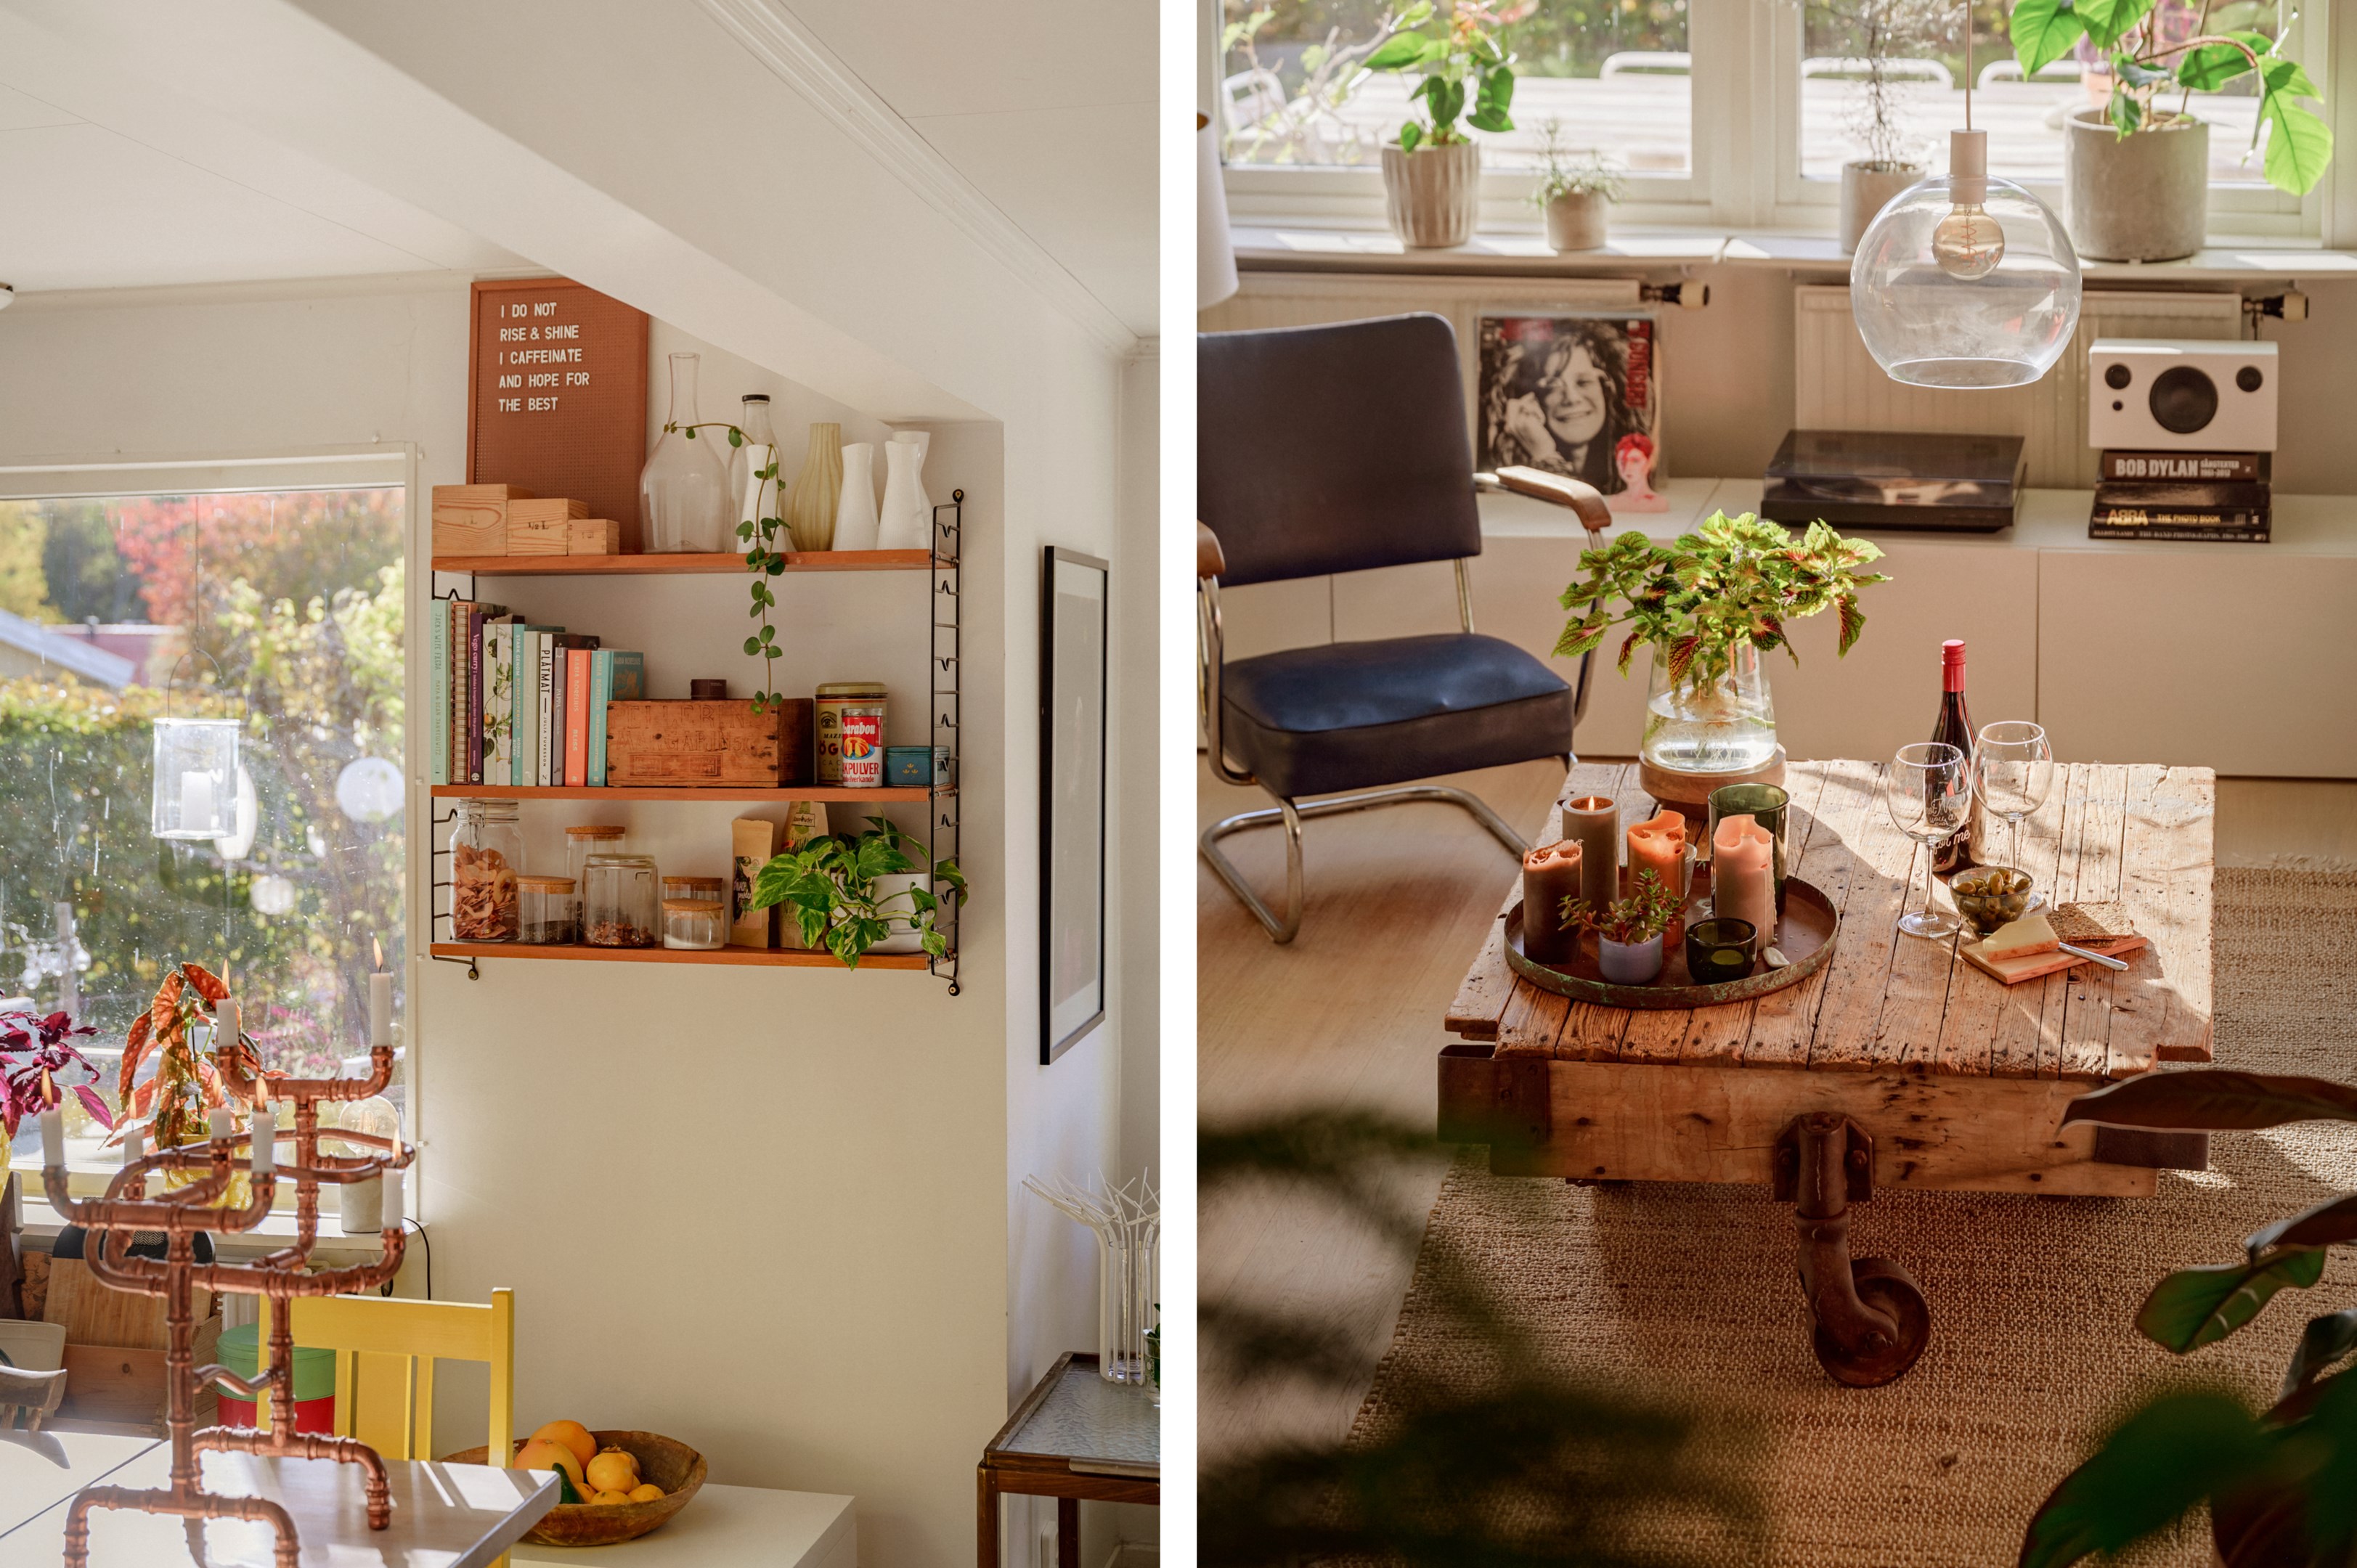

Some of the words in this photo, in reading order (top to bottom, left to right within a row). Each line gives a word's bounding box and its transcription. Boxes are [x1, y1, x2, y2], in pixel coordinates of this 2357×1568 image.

[500, 304, 505, 319] I
[511, 303, 528, 318] DO
[534, 301, 558, 317] NOT
[500, 327, 527, 342] RISE
[529, 326, 540, 340] &
[544, 324, 580, 340] SHINE
[499, 351, 503, 366] I
[510, 348, 583, 365] CAFFEINATE
[499, 375, 522, 389] AND
[528, 372, 560, 388] HOPE
[566, 372, 590, 387] FOR
[498, 398, 521, 413] THE
[528, 396, 558, 412] BEST
[2114, 458, 2147, 478] BOB
[2148, 458, 2199, 478] DYLAN
[2106, 509, 2149, 526] ABBA
[2157, 513, 2172, 523] THE
[2173, 514, 2199, 523] PHOTO
[2199, 514, 2222, 524] BOOK
[471, 633, 479, 651] Vego
[541, 649, 550, 694] PLÅTMAT
[819, 740, 842, 756] ÖG
[1953, 829, 1971, 845] me
